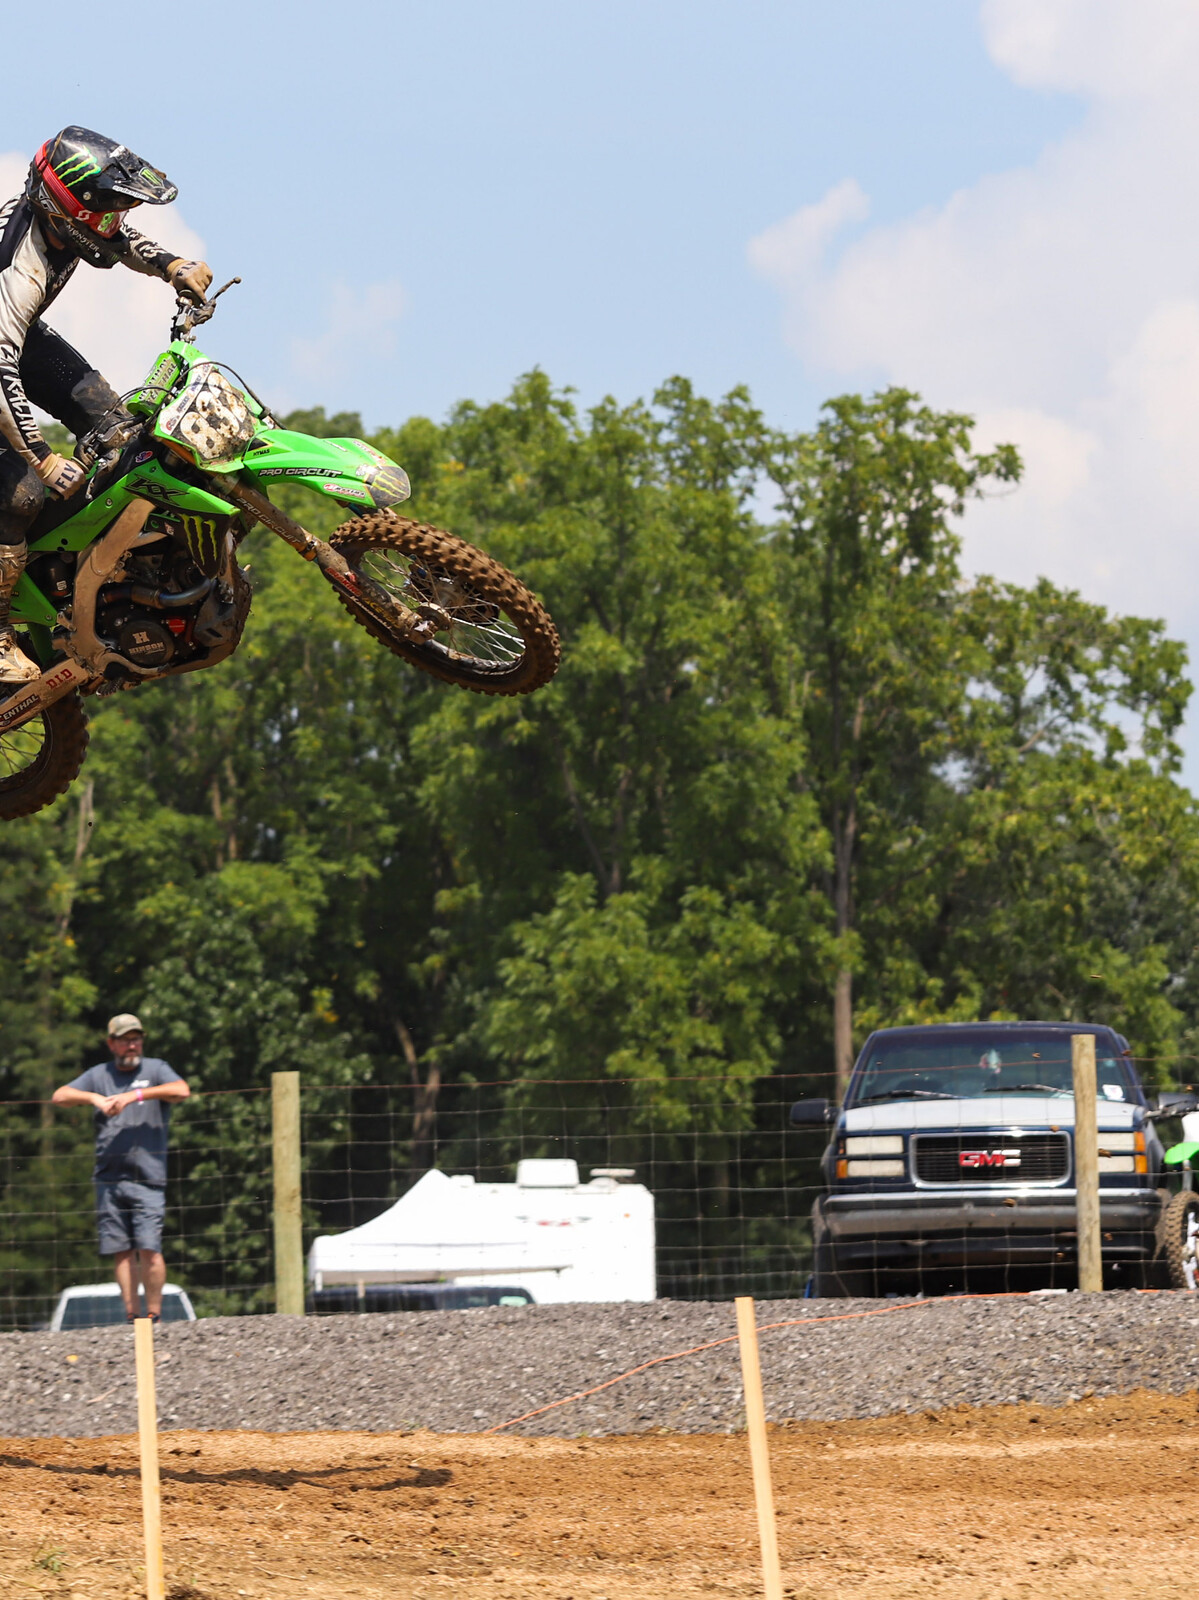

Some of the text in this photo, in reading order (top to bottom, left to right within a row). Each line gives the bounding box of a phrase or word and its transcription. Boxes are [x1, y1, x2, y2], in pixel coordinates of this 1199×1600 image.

[54, 463, 78, 490] FLY
[259, 468, 343, 478] PRO CIRCUIT
[236, 497, 301, 543] PRO CIRCUIT
[958, 1148, 1022, 1169] GMC
